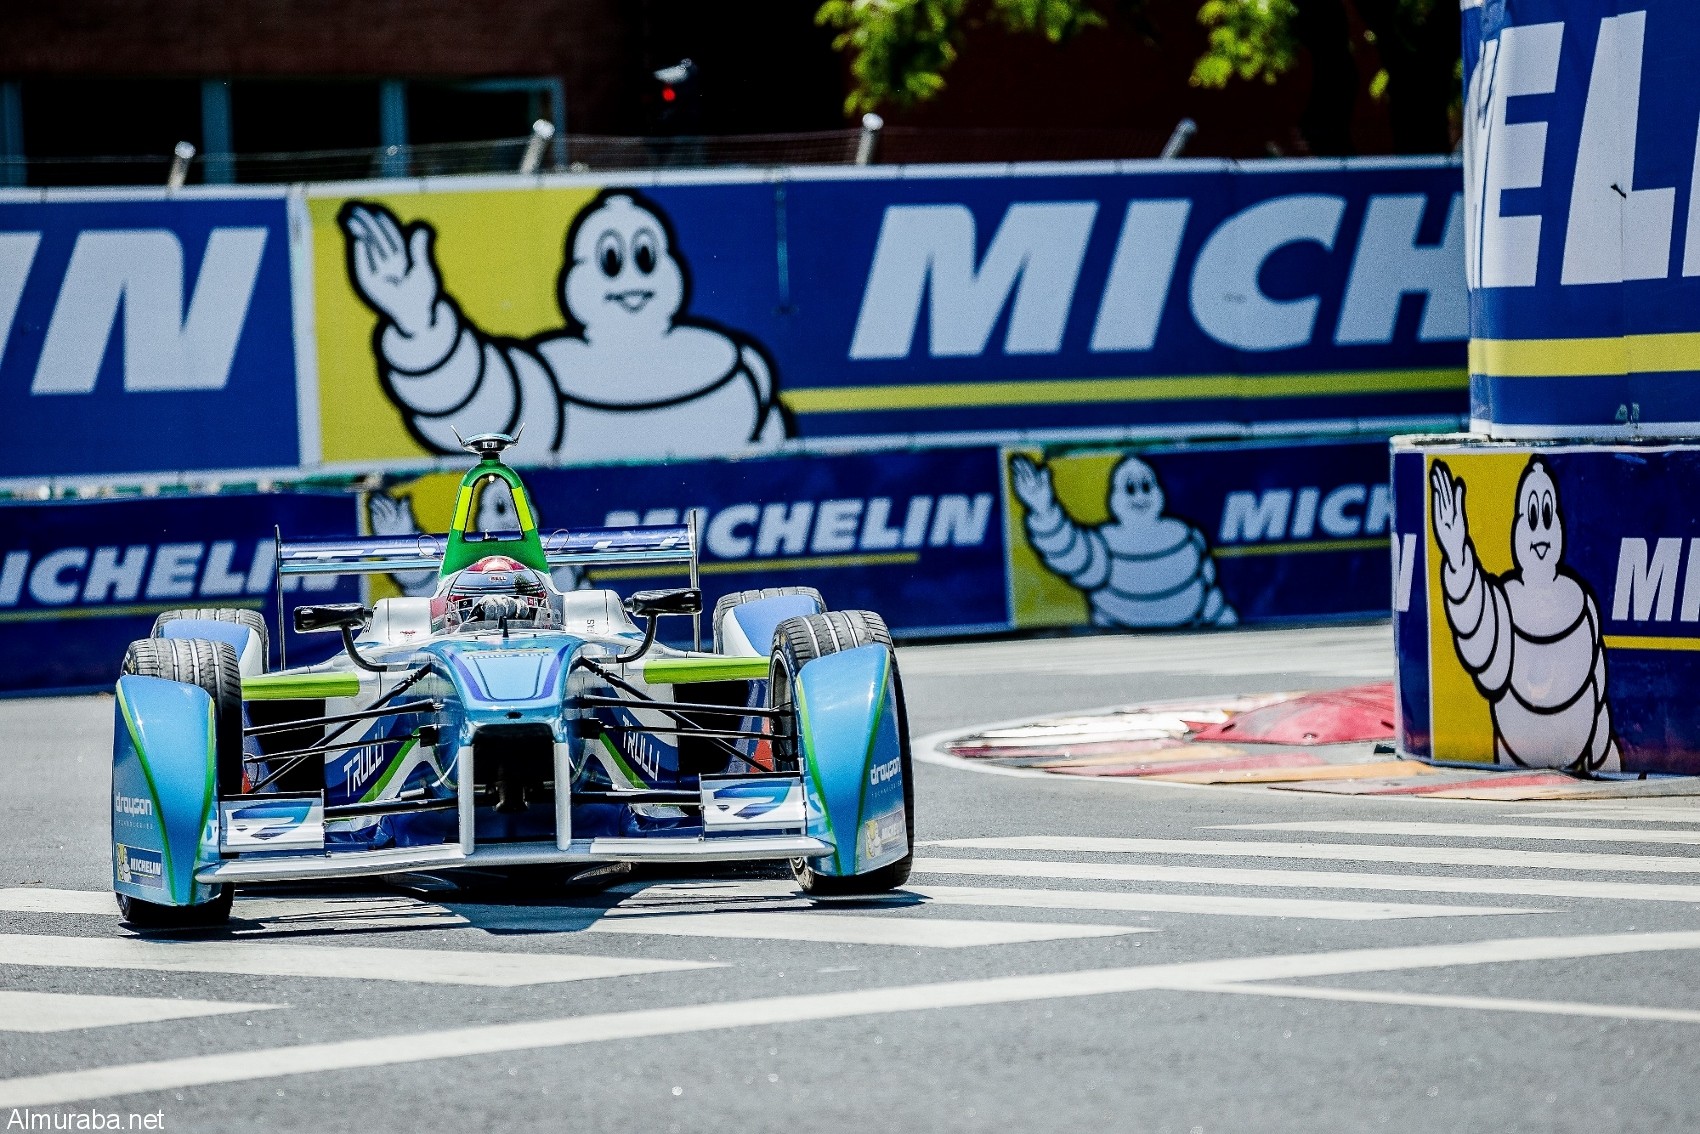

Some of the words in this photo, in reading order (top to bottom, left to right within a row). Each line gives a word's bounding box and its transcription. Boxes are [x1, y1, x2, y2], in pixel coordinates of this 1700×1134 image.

[848, 192, 1468, 359] MICH
[343, 725, 384, 798] TRULLI
[115, 791, 153, 818] drayson
